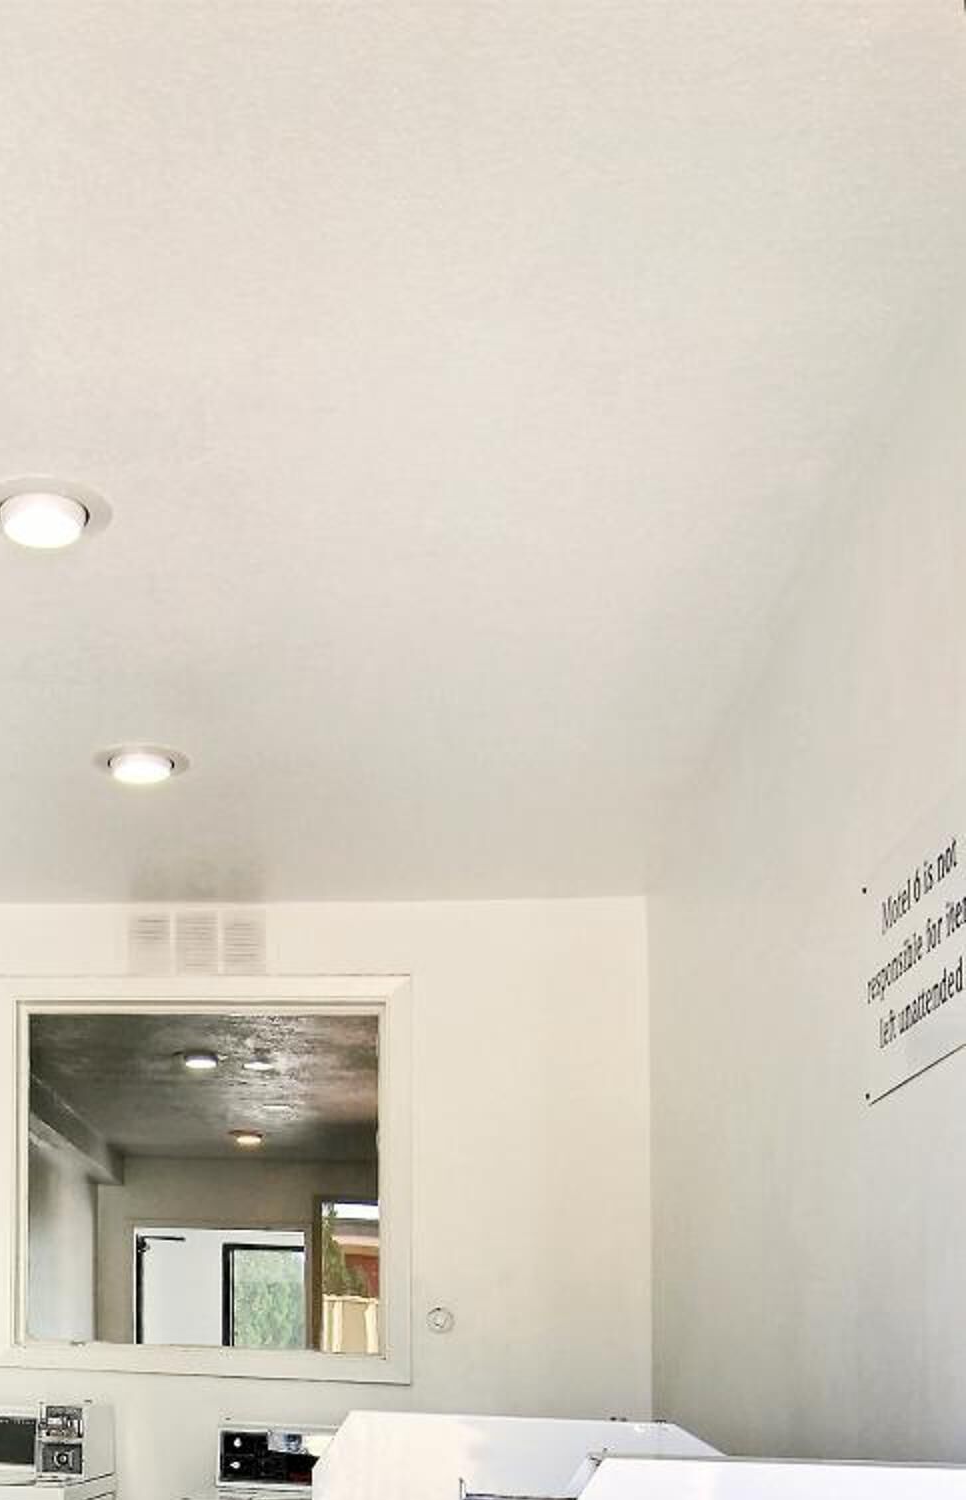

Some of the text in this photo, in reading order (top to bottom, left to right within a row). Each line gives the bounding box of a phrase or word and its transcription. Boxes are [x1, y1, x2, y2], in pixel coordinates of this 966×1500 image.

[881, 837, 958, 934] Motel 6 is not
[866, 931, 924, 1005] responsible
[926, 916, 944, 954] for
[879, 955, 963, 1048] left unattended
